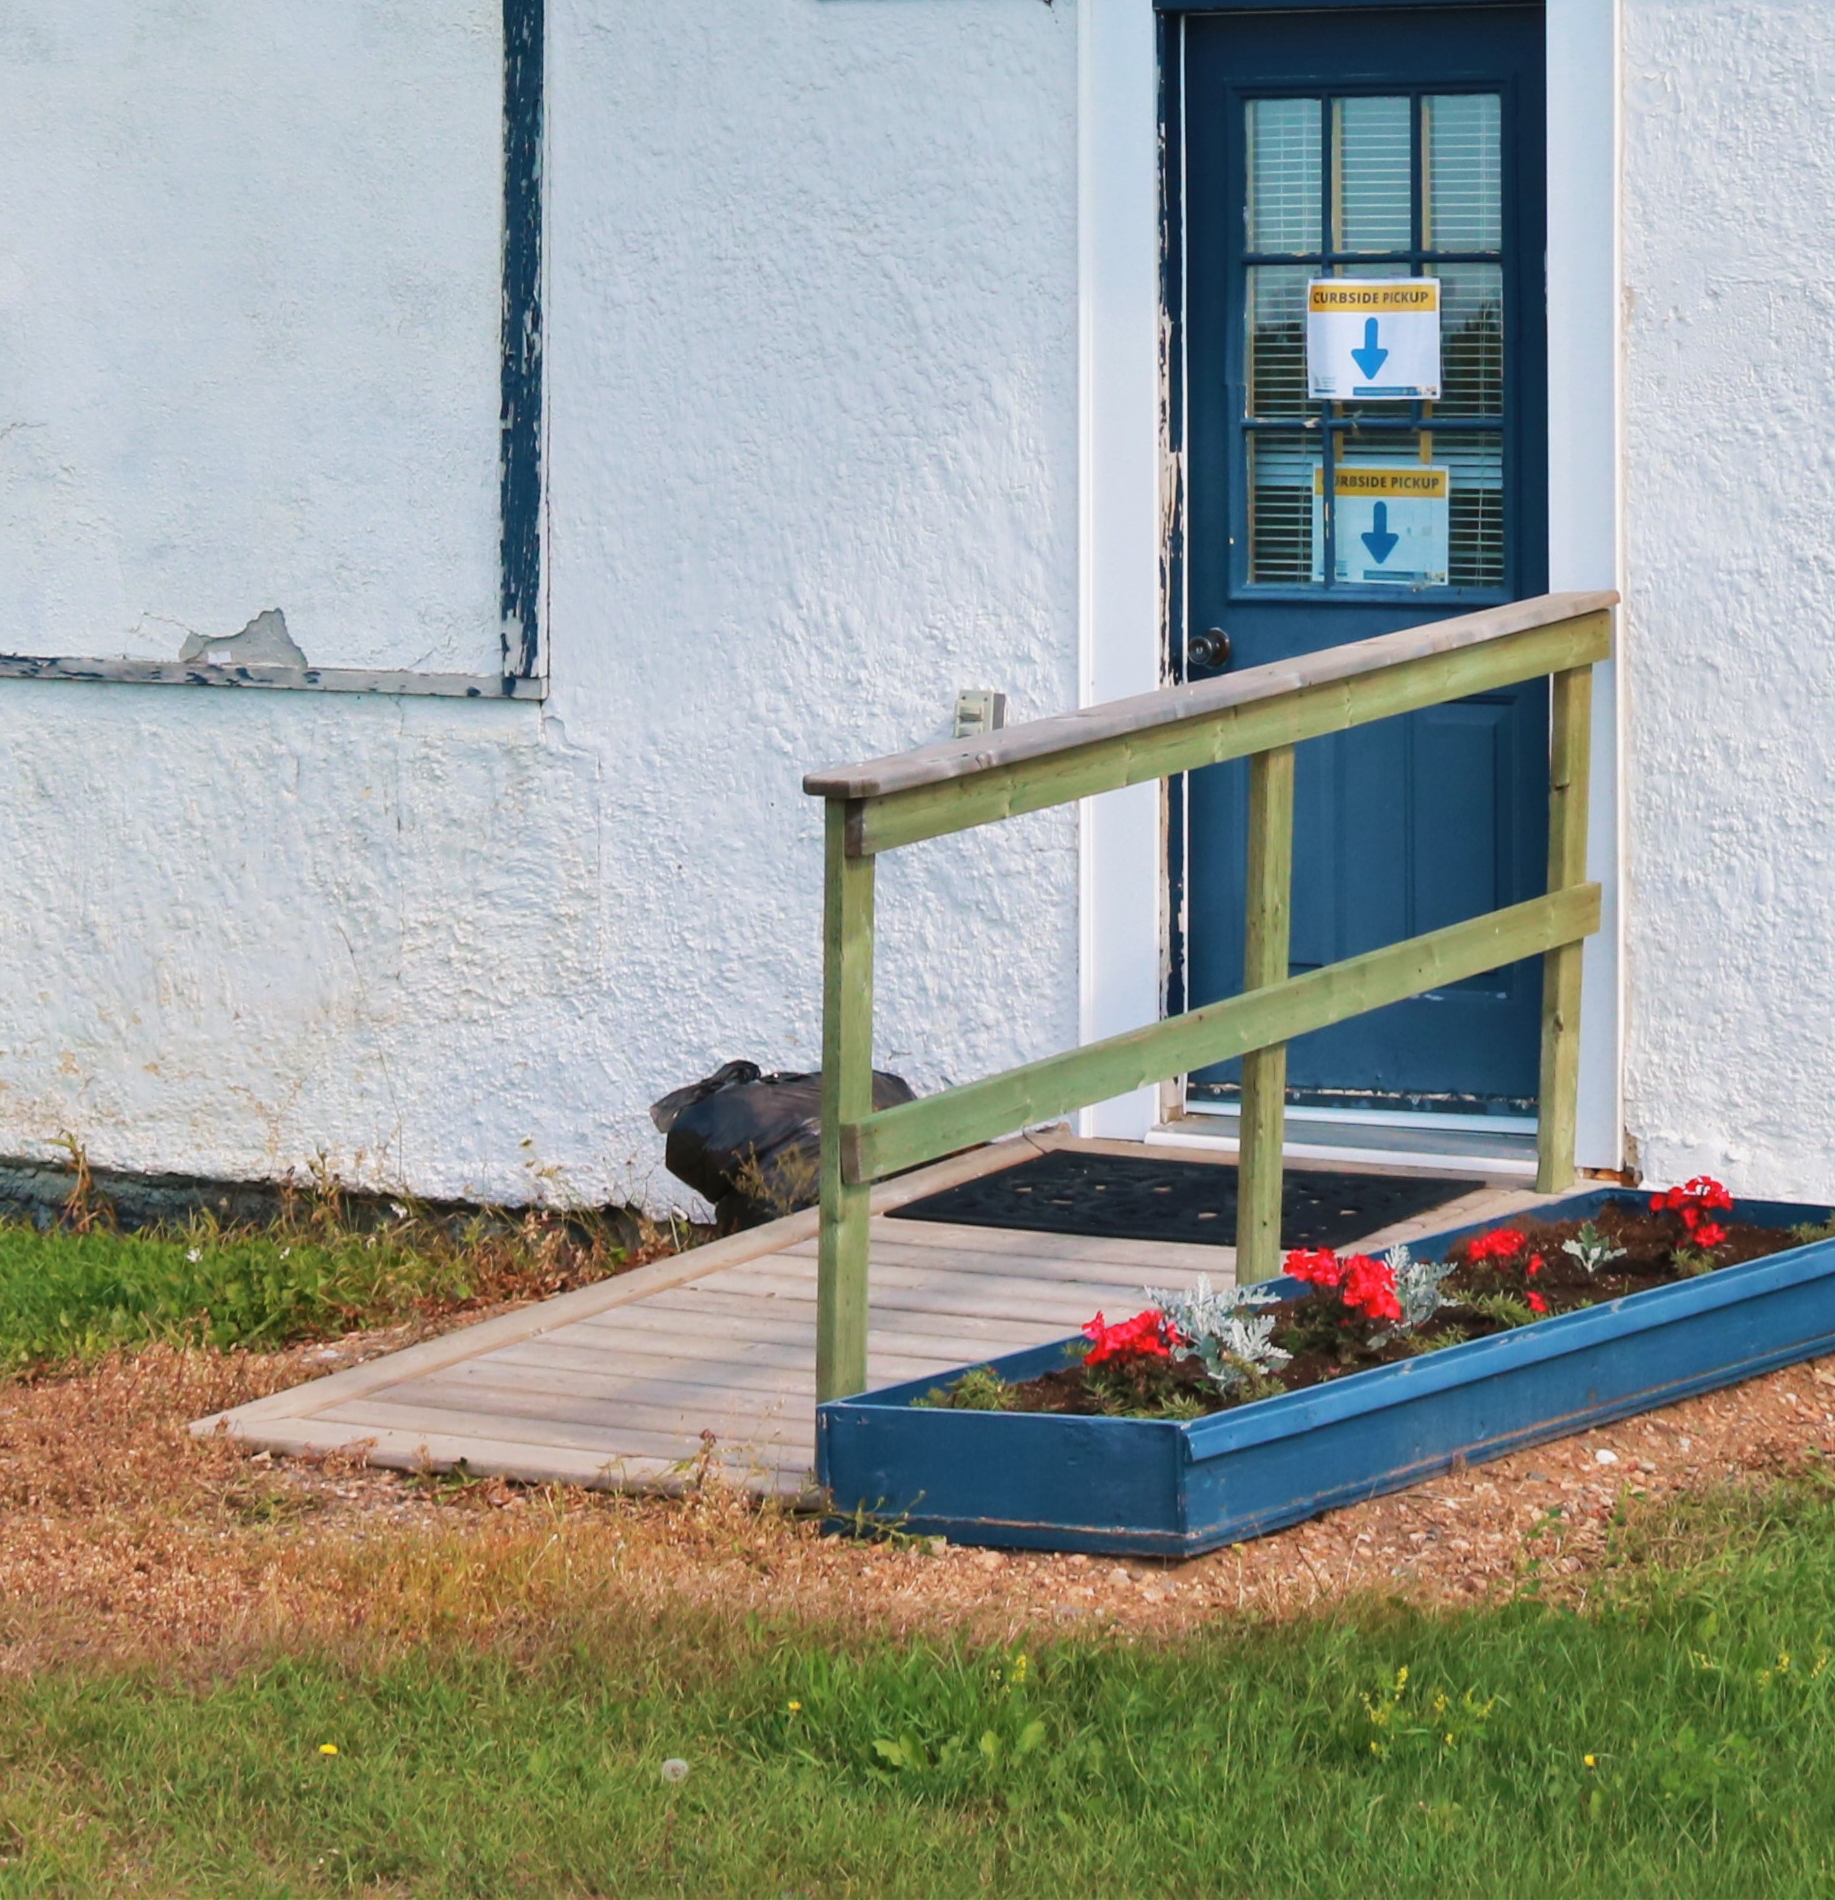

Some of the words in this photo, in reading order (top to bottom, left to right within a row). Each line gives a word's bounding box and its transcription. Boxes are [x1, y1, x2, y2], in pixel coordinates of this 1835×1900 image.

[1313, 292, 1379, 305] CURBSIDE
[1382, 291, 1429, 304] PICKUP
[1391, 477, 1440, 489] PICKUP
